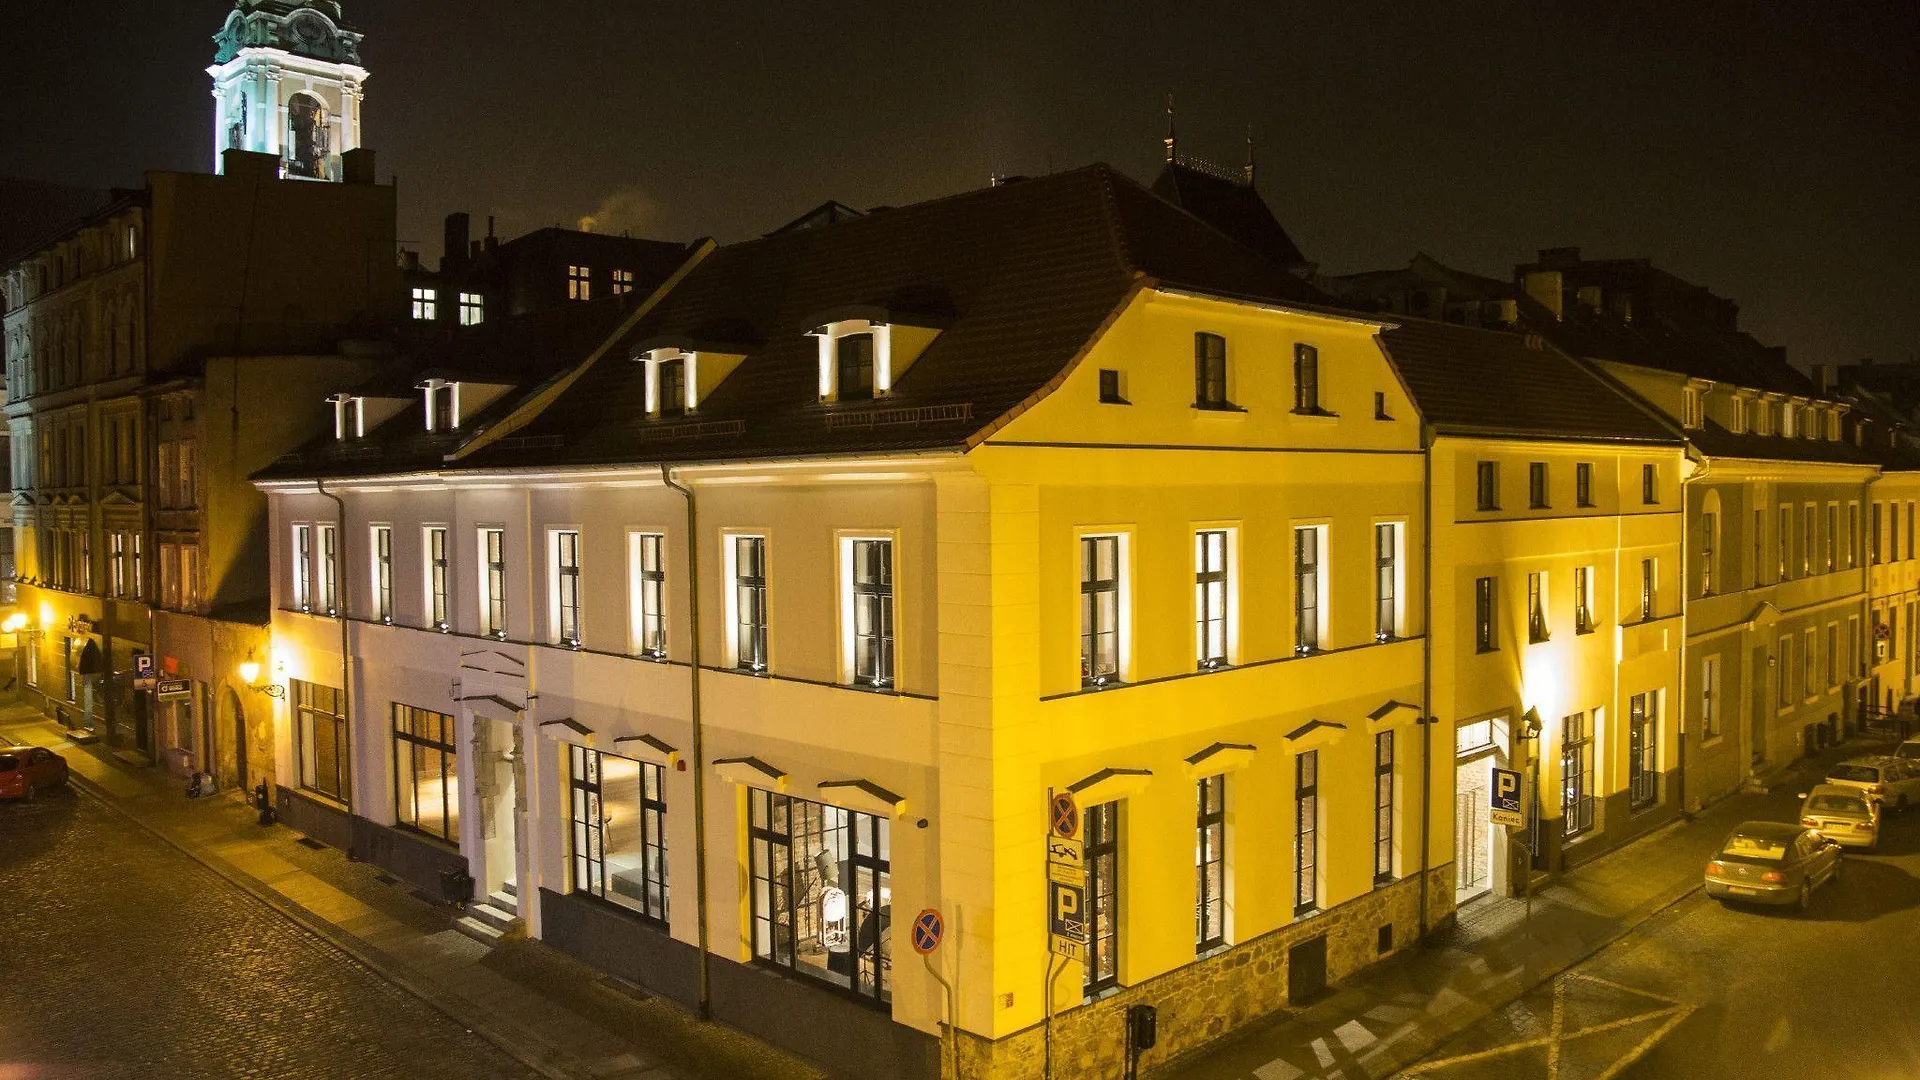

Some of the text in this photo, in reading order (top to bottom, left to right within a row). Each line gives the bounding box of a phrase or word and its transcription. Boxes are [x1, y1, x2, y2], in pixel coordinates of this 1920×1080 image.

[138, 656, 151, 672] P
[1498, 772, 1516, 798] P
[1492, 813, 1520, 824] Koniec
[1058, 886, 1078, 921] P
[1059, 939, 1077, 956] HIT
